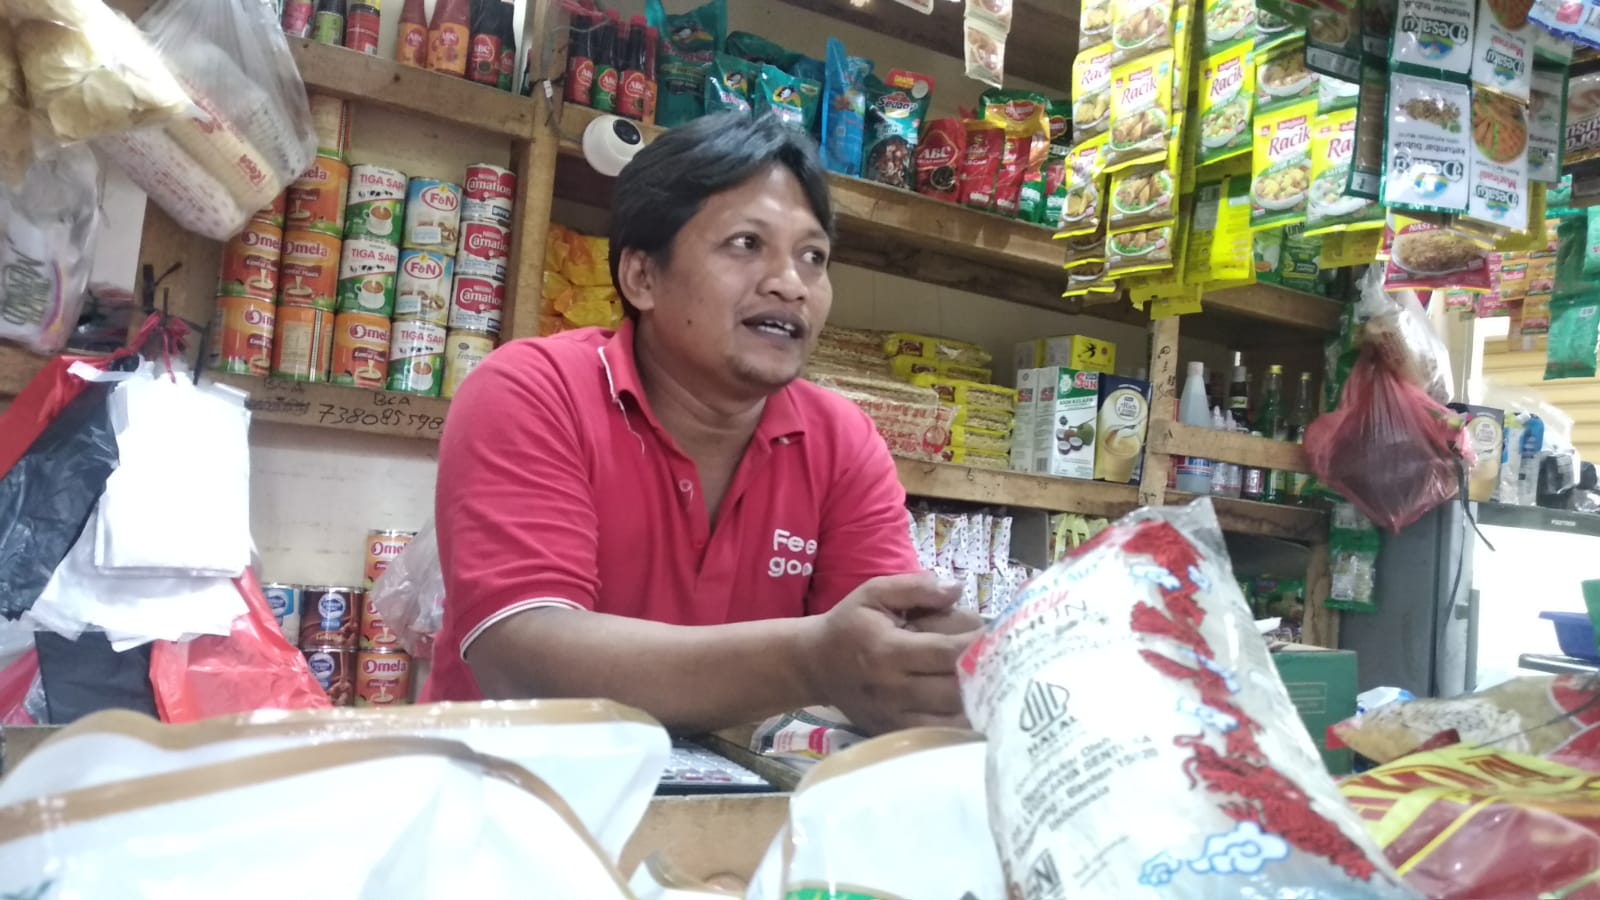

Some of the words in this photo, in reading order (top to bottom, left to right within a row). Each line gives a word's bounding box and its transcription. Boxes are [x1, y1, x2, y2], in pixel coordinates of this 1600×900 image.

[1402, 15, 1469, 46] Desaku
[1486, 48, 1525, 76] Desaku
[1121, 76, 1156, 104] Racik
[1210, 66, 1243, 96] Racik
[1269, 126, 1310, 156] Racik
[1327, 138, 1351, 158] Ra
[921, 146, 950, 159] ABC
[360, 174, 384, 185] TIGA
[466, 177, 512, 195] Carnation
[1475, 184, 1520, 209] Desaku
[1409, 222, 1432, 232] NASI
[469, 233, 510, 250] Carnatio
[351, 248, 375, 259] TIGA
[460, 287, 501, 304] Carnatio
[351, 324, 389, 341] Omel
[400, 330, 424, 343] TIGA
[374, 393, 411, 407] BCA
[773, 529, 817, 555] Fee
[768, 557, 813, 577] goo
[363, 659, 407, 674] Omela
[1026, 715, 1078, 760] HALAL
